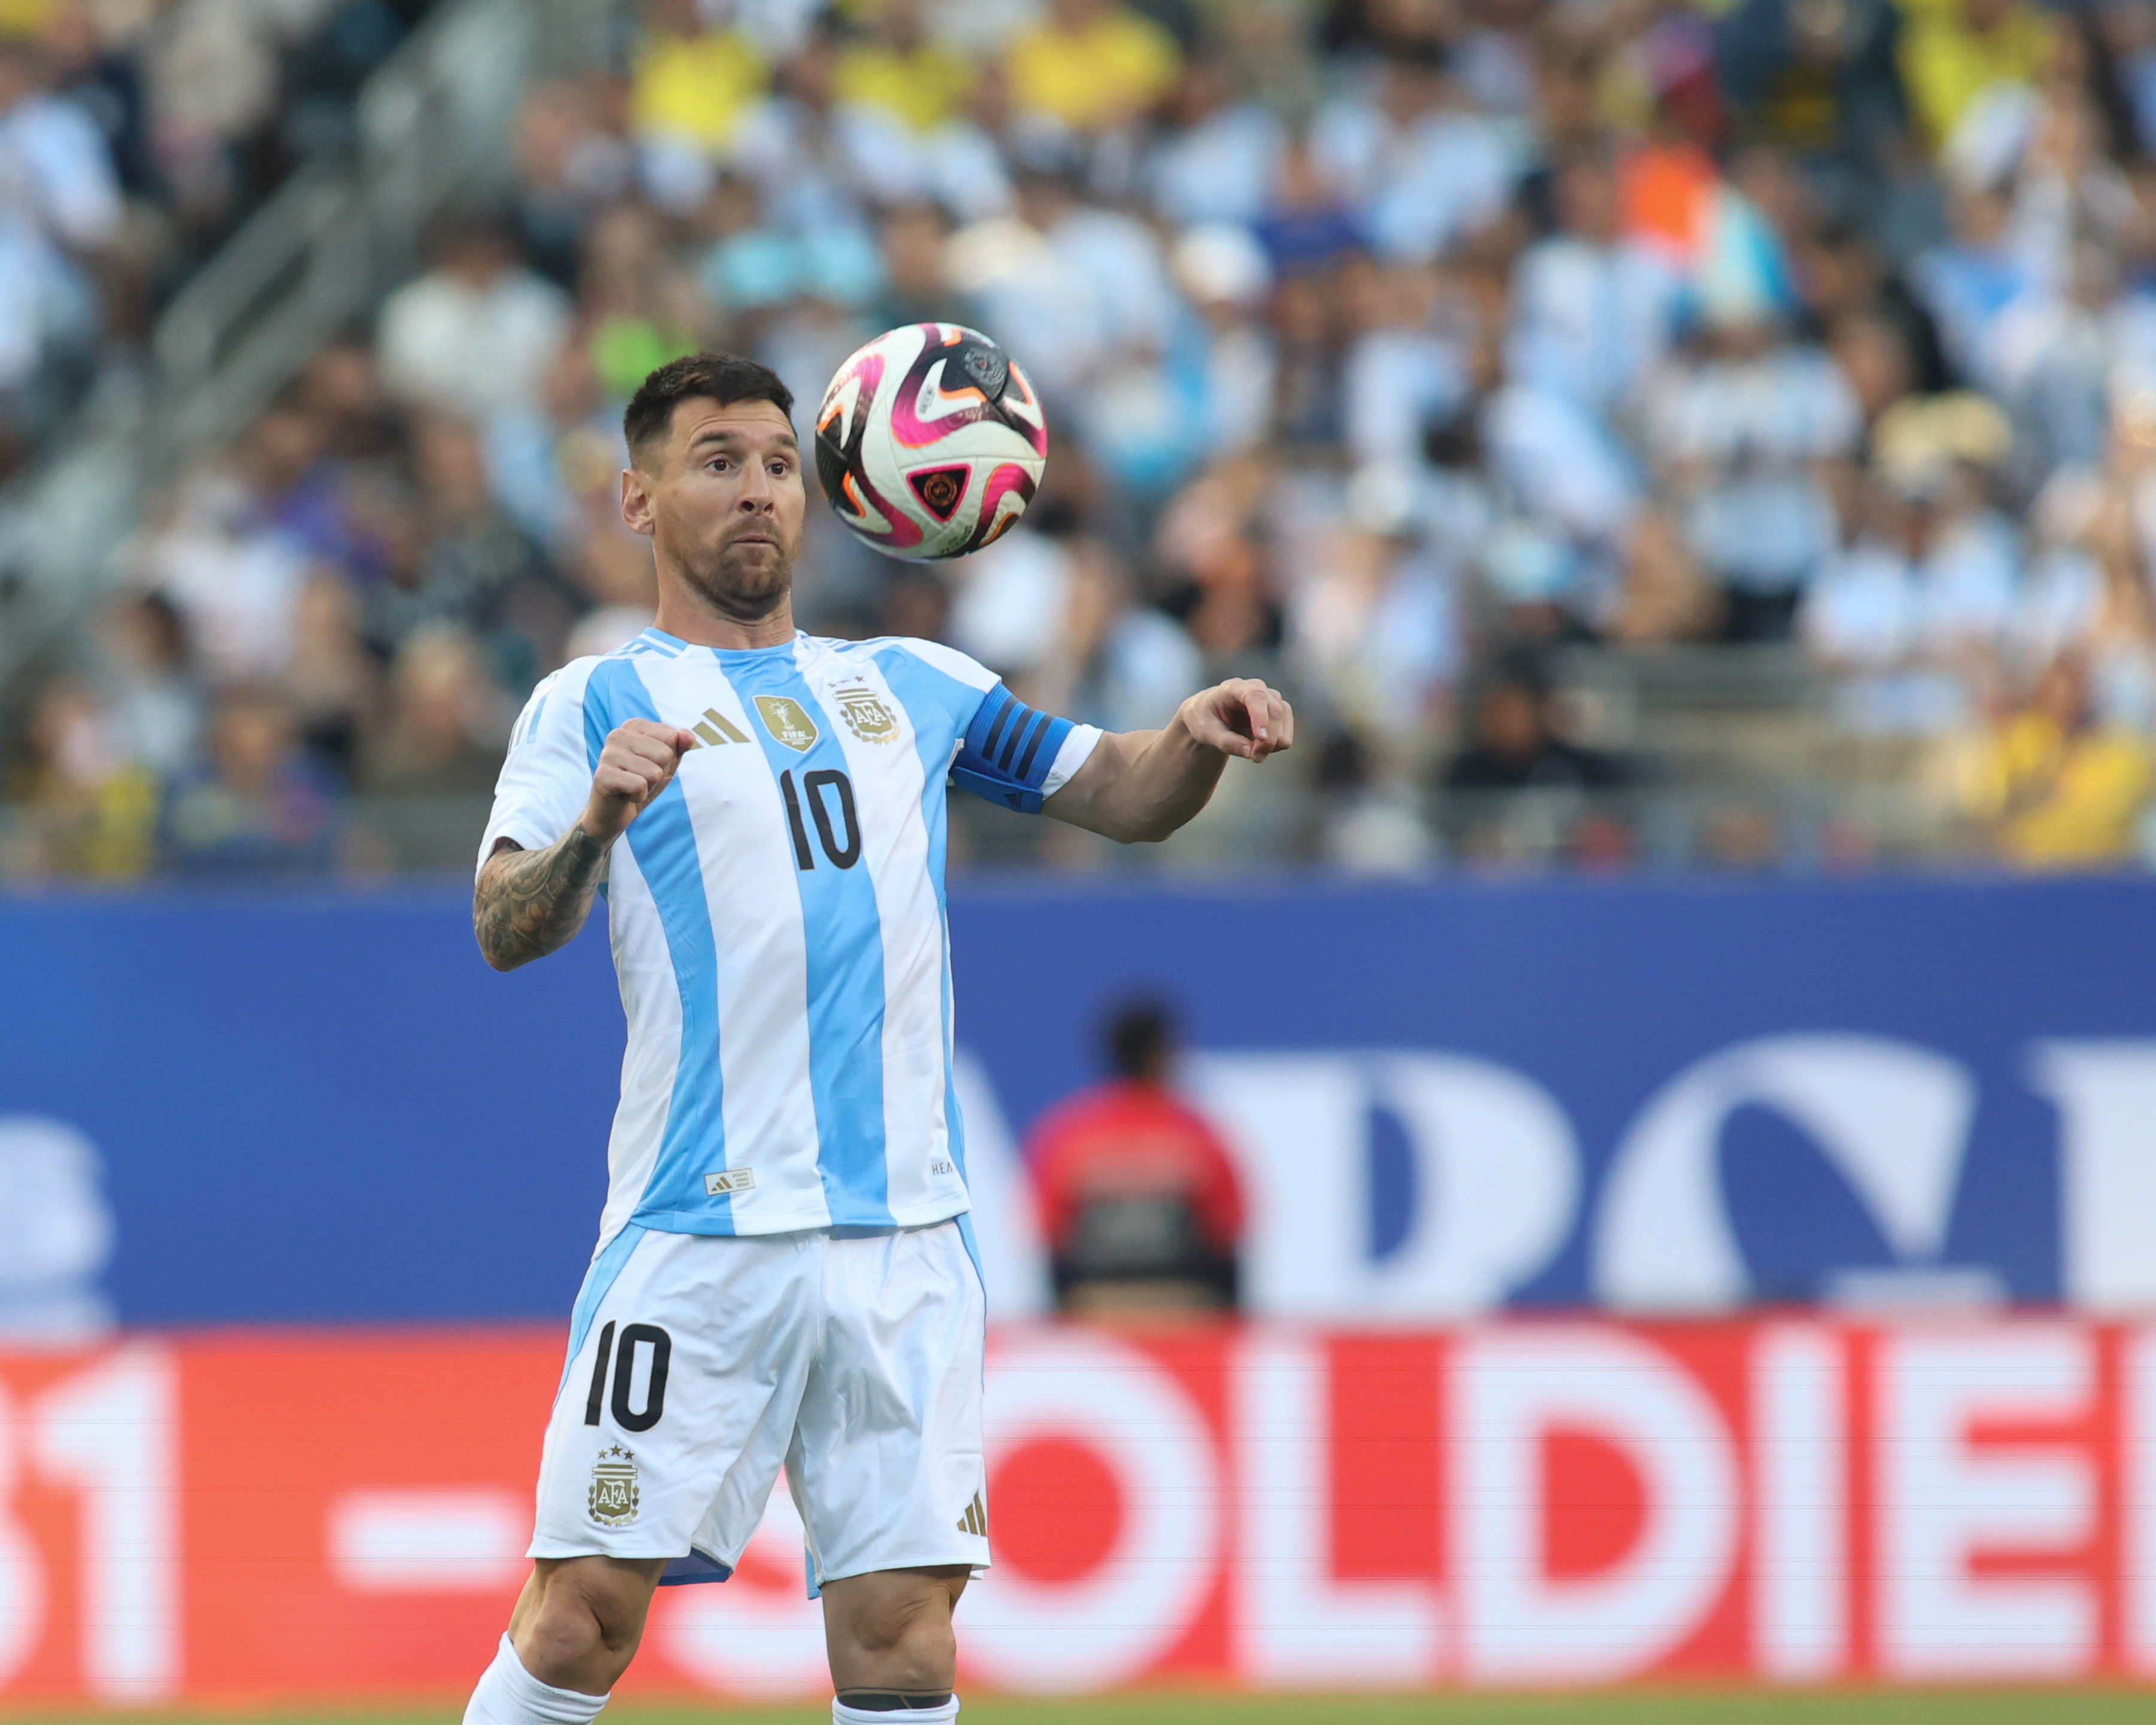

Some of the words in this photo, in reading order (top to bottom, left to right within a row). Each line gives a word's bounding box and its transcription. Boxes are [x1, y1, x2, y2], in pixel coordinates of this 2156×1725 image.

[850, 701, 887, 727] AFA
[780, 769, 861, 871] 10
[585, 1320, 671, 1432] 10
[598, 1480, 629, 1509] AFA
